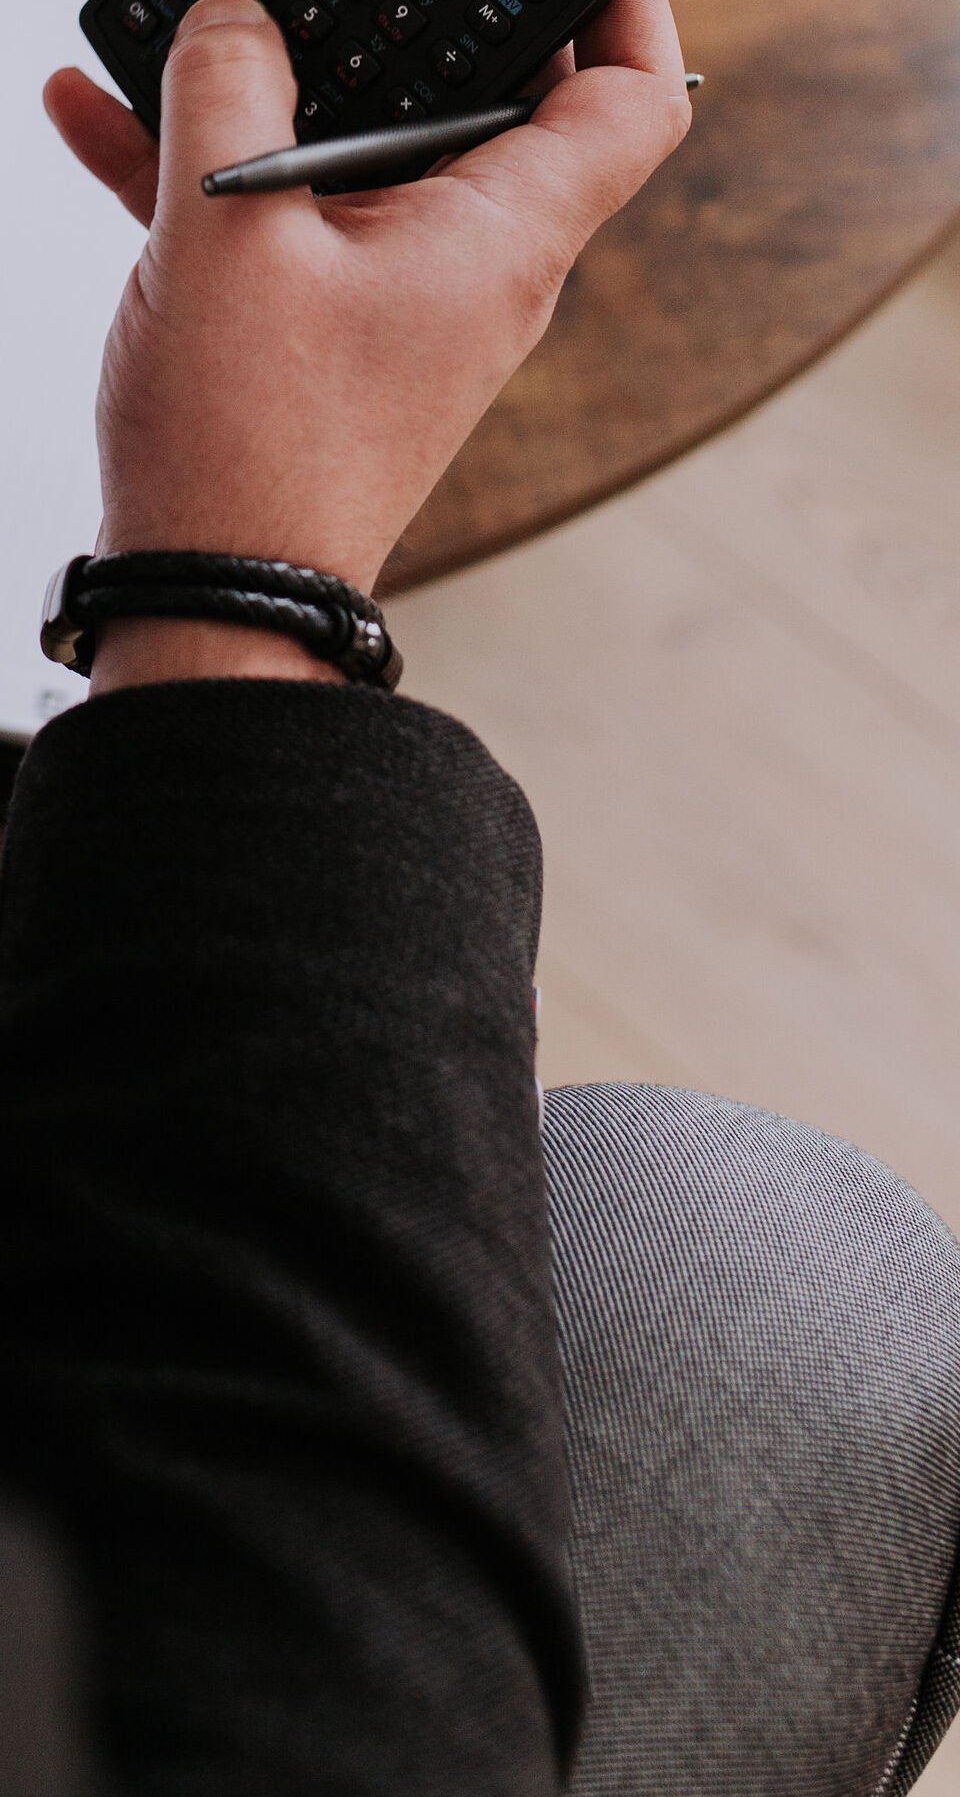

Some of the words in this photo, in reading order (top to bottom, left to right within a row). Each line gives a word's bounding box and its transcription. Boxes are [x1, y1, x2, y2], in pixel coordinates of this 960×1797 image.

[129, 1, 151, 24] ON
[303, 5, 319, 22] 5
[394, 4, 410, 20] 9
[458, 33, 481, 55] SIN
[349, 54, 363, 70] 6
[304, 99, 319, 117] 3
